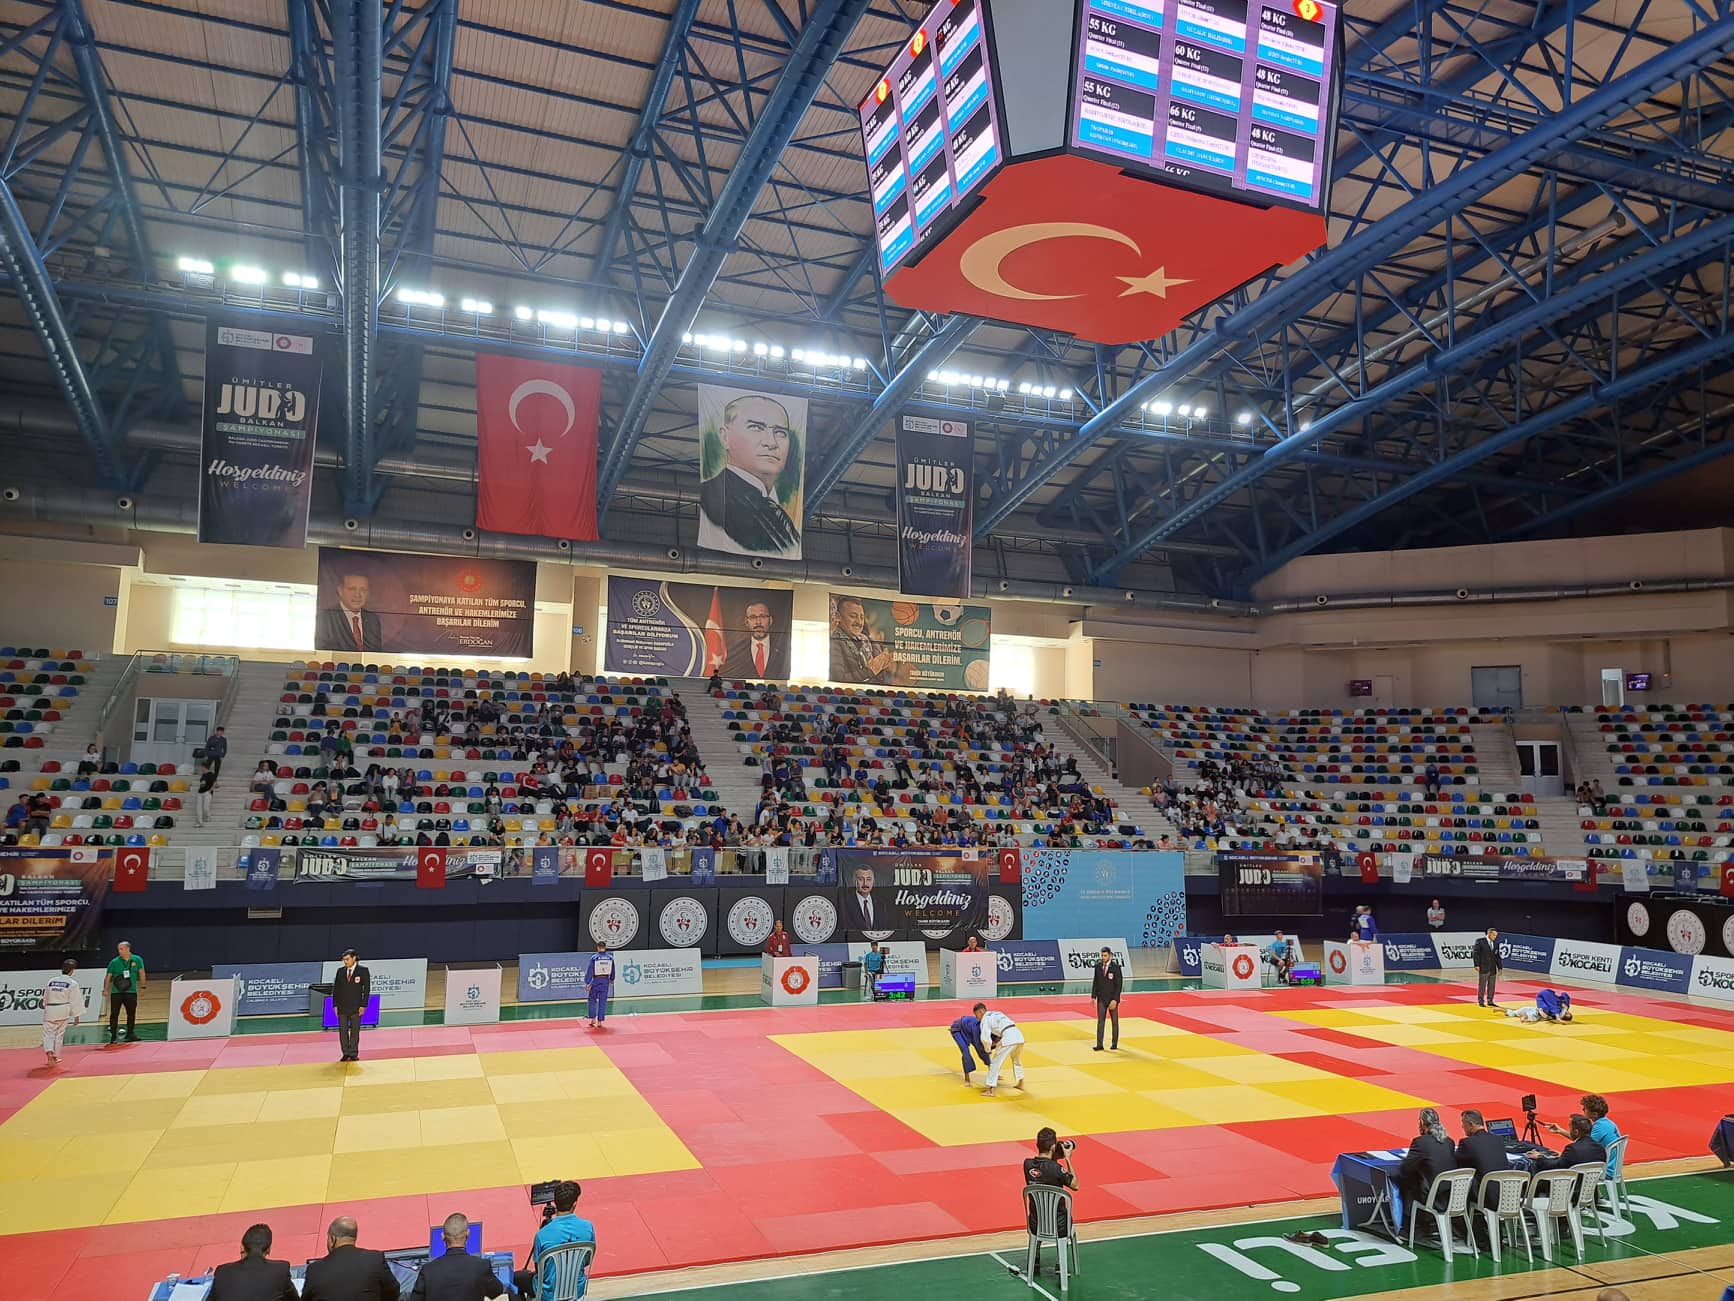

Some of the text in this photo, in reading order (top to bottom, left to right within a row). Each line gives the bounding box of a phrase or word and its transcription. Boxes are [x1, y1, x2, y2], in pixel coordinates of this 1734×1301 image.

[1261, 9, 1286, 26] 48 KG
[1089, 17, 1116, 36] 55 KG
[1175, 44, 1201, 61] 60 KG
[1256, 68, 1280, 84] 48 KG
[1083, 80, 1110, 98] 55 KG
[1169, 105, 1195, 121] 66 KG
[1251, 127, 1275, 143] 48 KG
[217, 383, 306, 422] JUDO
[239, 418, 285, 427] BALKAN
[208, 459, 306, 487] Hoşgeldiniz
[905, 463, 965, 494] JUDO
[901, 526, 967, 548] Hoşgeldiniz
[409, 594, 527, 609] ŞAMPİYONAYA KATILAN TÜM SPORCU,
[418, 606, 518, 619] ANTRENÖR VE HAKEMLERİMİZE
[436, 618, 500, 628] BAŞARILAR DİLERİM
[895, 627, 962, 641] SPORCU, ANTRENÖR
[895, 640, 962, 653] VE HAKEMLERİMİZE
[893, 652, 931, 665] BAŞARILAR
[301, 857, 347, 875] JUDO
[1426, 860, 1461, 874] JUDO
[1503, 860, 1556, 873] Hoşgeldiniz
[894, 868, 933, 886] JUDO
[1239, 868, 1271, 885] JUDO
[36, 898, 54, 906] TÜM
[894, 889, 972, 910] Hoşgeldiniz
[904, 909, 961, 917] WELCOME
[22, 917, 63, 925] DİLERİM
[1572, 953, 1591, 961] SPOR
[1642, 960, 1667, 968] KOCAELİ
[1570, 959, 1611, 973] KOCAELİ
